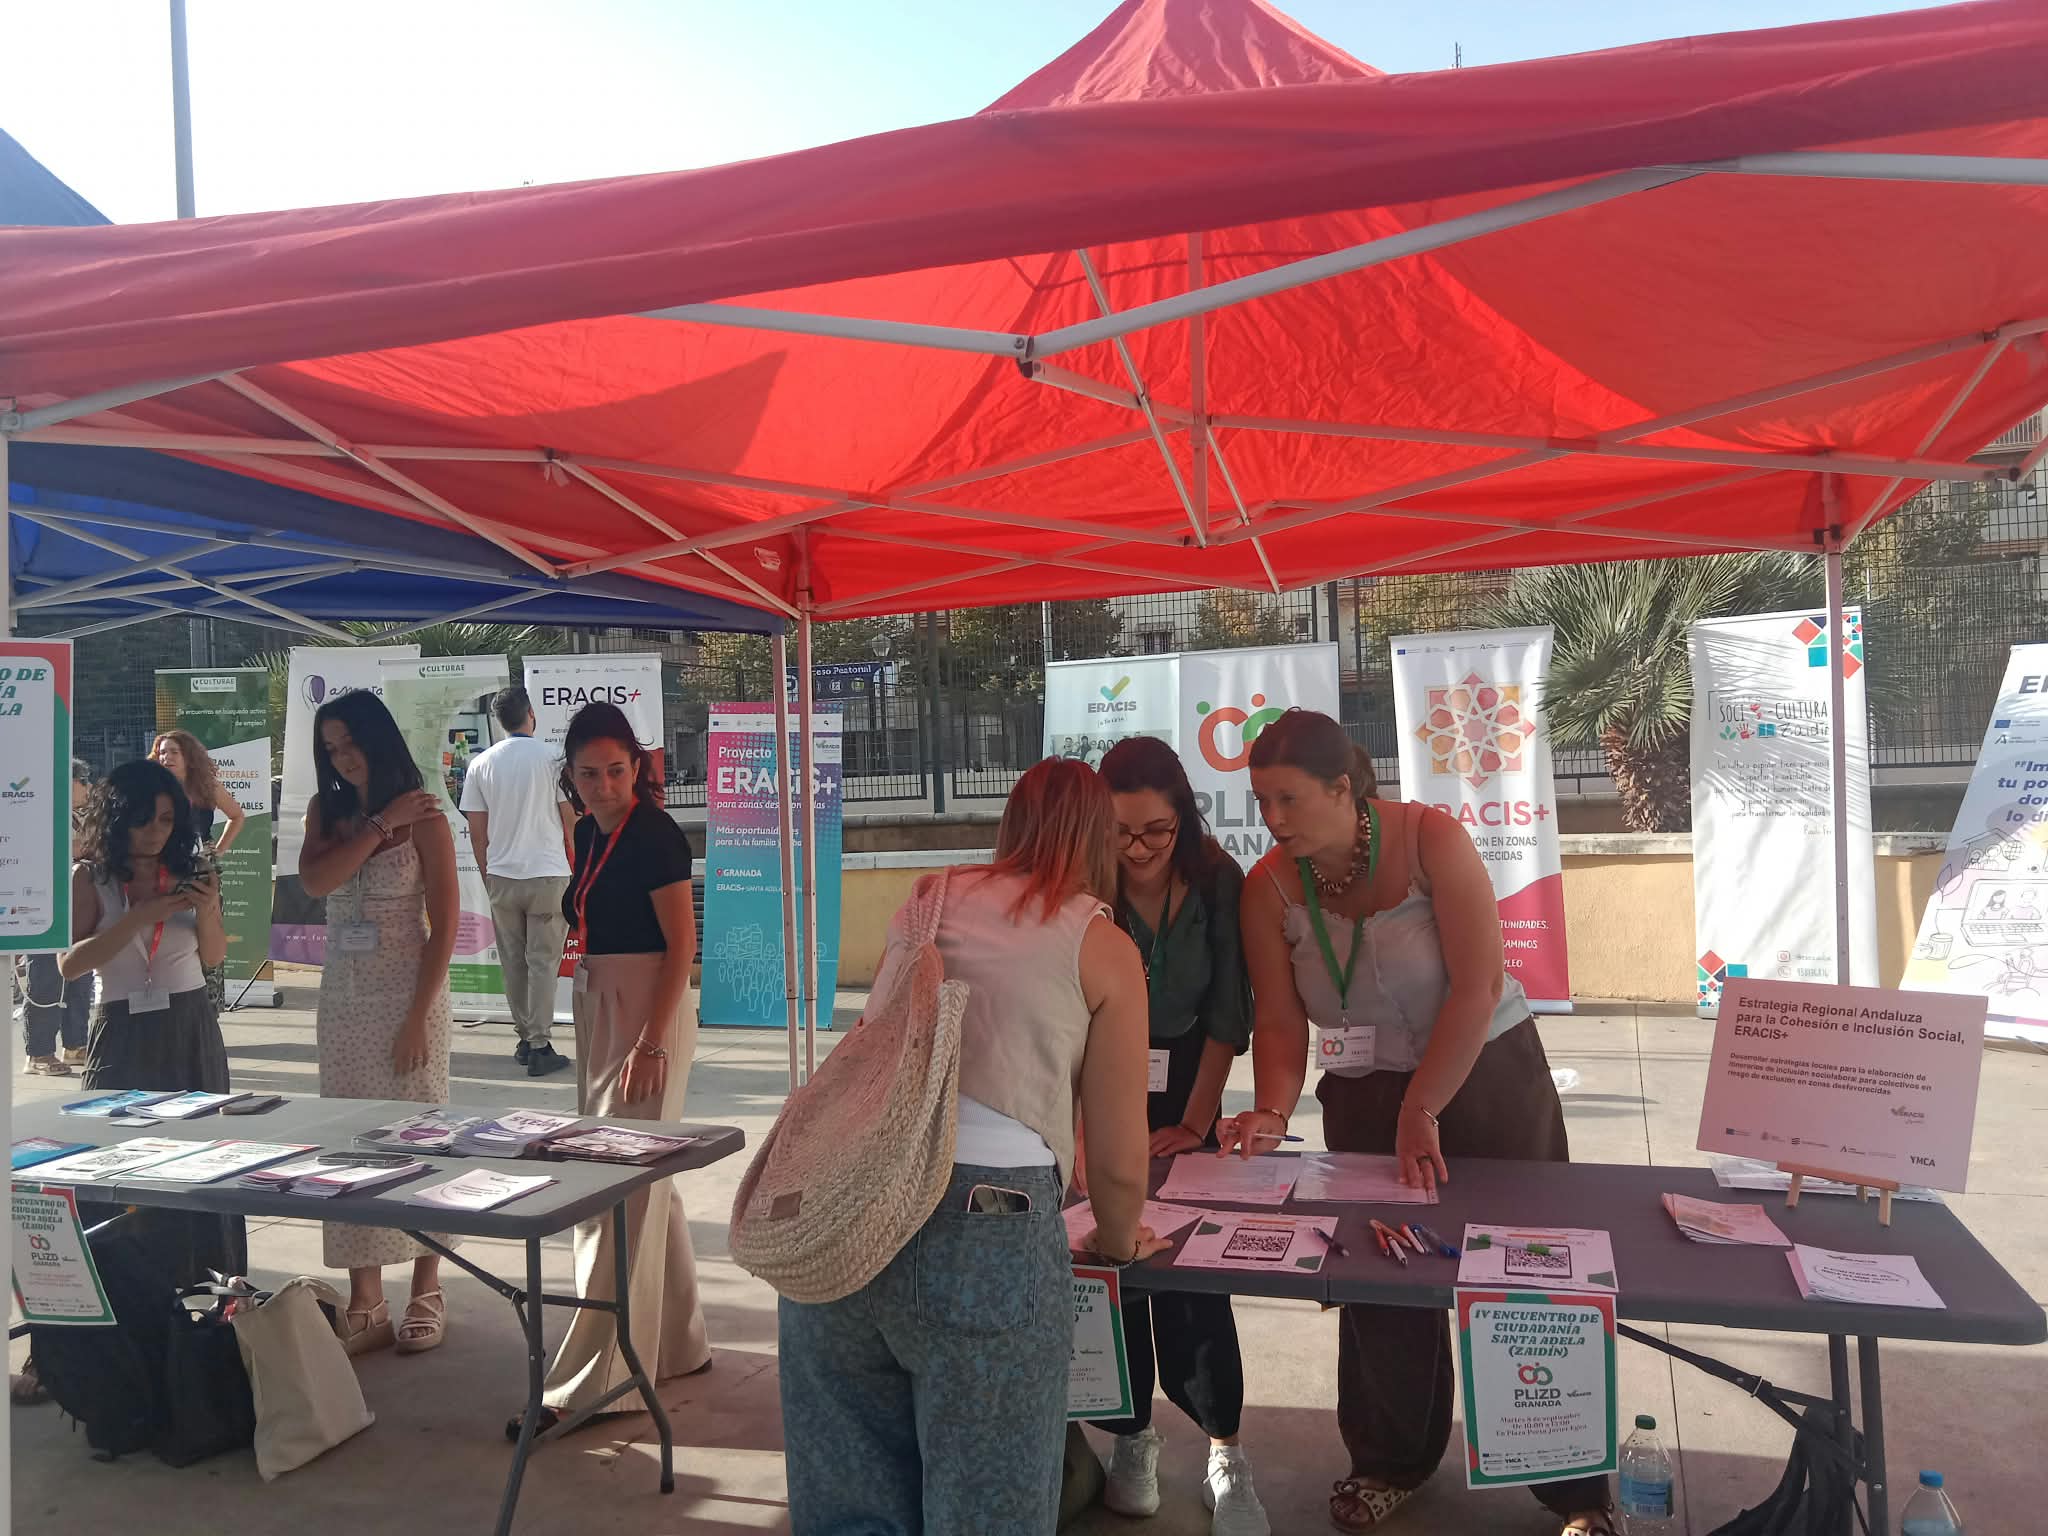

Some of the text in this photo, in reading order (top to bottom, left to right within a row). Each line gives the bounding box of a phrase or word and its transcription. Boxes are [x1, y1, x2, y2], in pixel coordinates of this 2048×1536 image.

[427, 664, 465, 672] CULTURAE
[833, 665, 871, 675] Peatonal
[16, 668, 47, 681] DE
[1087, 701, 1137, 713] ERACIS
[719, 746, 772, 761] Proyecto
[1998, 777, 2017, 788] tu
[716, 801, 736, 809] para
[738, 800, 763, 809] zonas
[2006, 810, 2024, 822] lo
[716, 826, 734, 834] Más
[751, 837, 776, 847] familia
[1491, 837, 1504, 847] EN
[1506, 836, 1538, 847] ZONAS
[723, 869, 762, 877] GRANADA
[716, 883, 745, 892] ERACIS+
[1739, 997, 1923, 1023] Estrategia Regional Andaluza
[1734, 1025, 1789, 1040] ERACIS+
[1736, 1013, 1965, 1044] para la Cohesión e Inclusión Social,
[1730, 1052, 1926, 1082] Desarrollar estrategias locales para la elaboración de
[1727, 1069, 1750, 1079] riesgo
[1751, 1072, 1760, 1080] de
[1761, 1074, 1796, 1085] exclusión
[1808, 1080, 1831, 1089] zonas
[1832, 1083, 1891, 1096] desfavorecidas
[1765, 1065, 1775, 1073] de
[1776, 1066, 1809, 1077] inclusión
[1811, 1071, 1857, 1082] sociolaboral
[1858, 1076, 1877, 1086] para
[1878, 1079, 1920, 1090] colectivos
[1921, 1084, 1932, 1092] en
[1910, 1155, 1936, 1167] YMCA
[1088, 1285, 1105, 1294] DE
[1475, 1309, 1600, 1323] IV ENCUENTRO DE
[1494, 1322, 1581, 1335] CIUDADANÍA
[1490, 1334, 1586, 1346] SANTA ADELA
[1508, 1345, 1569, 1358] (ZAIDÍN)
[1514, 1388, 1562, 1400] PLIZD
[1514, 1400, 1562, 1408] GRANADA
